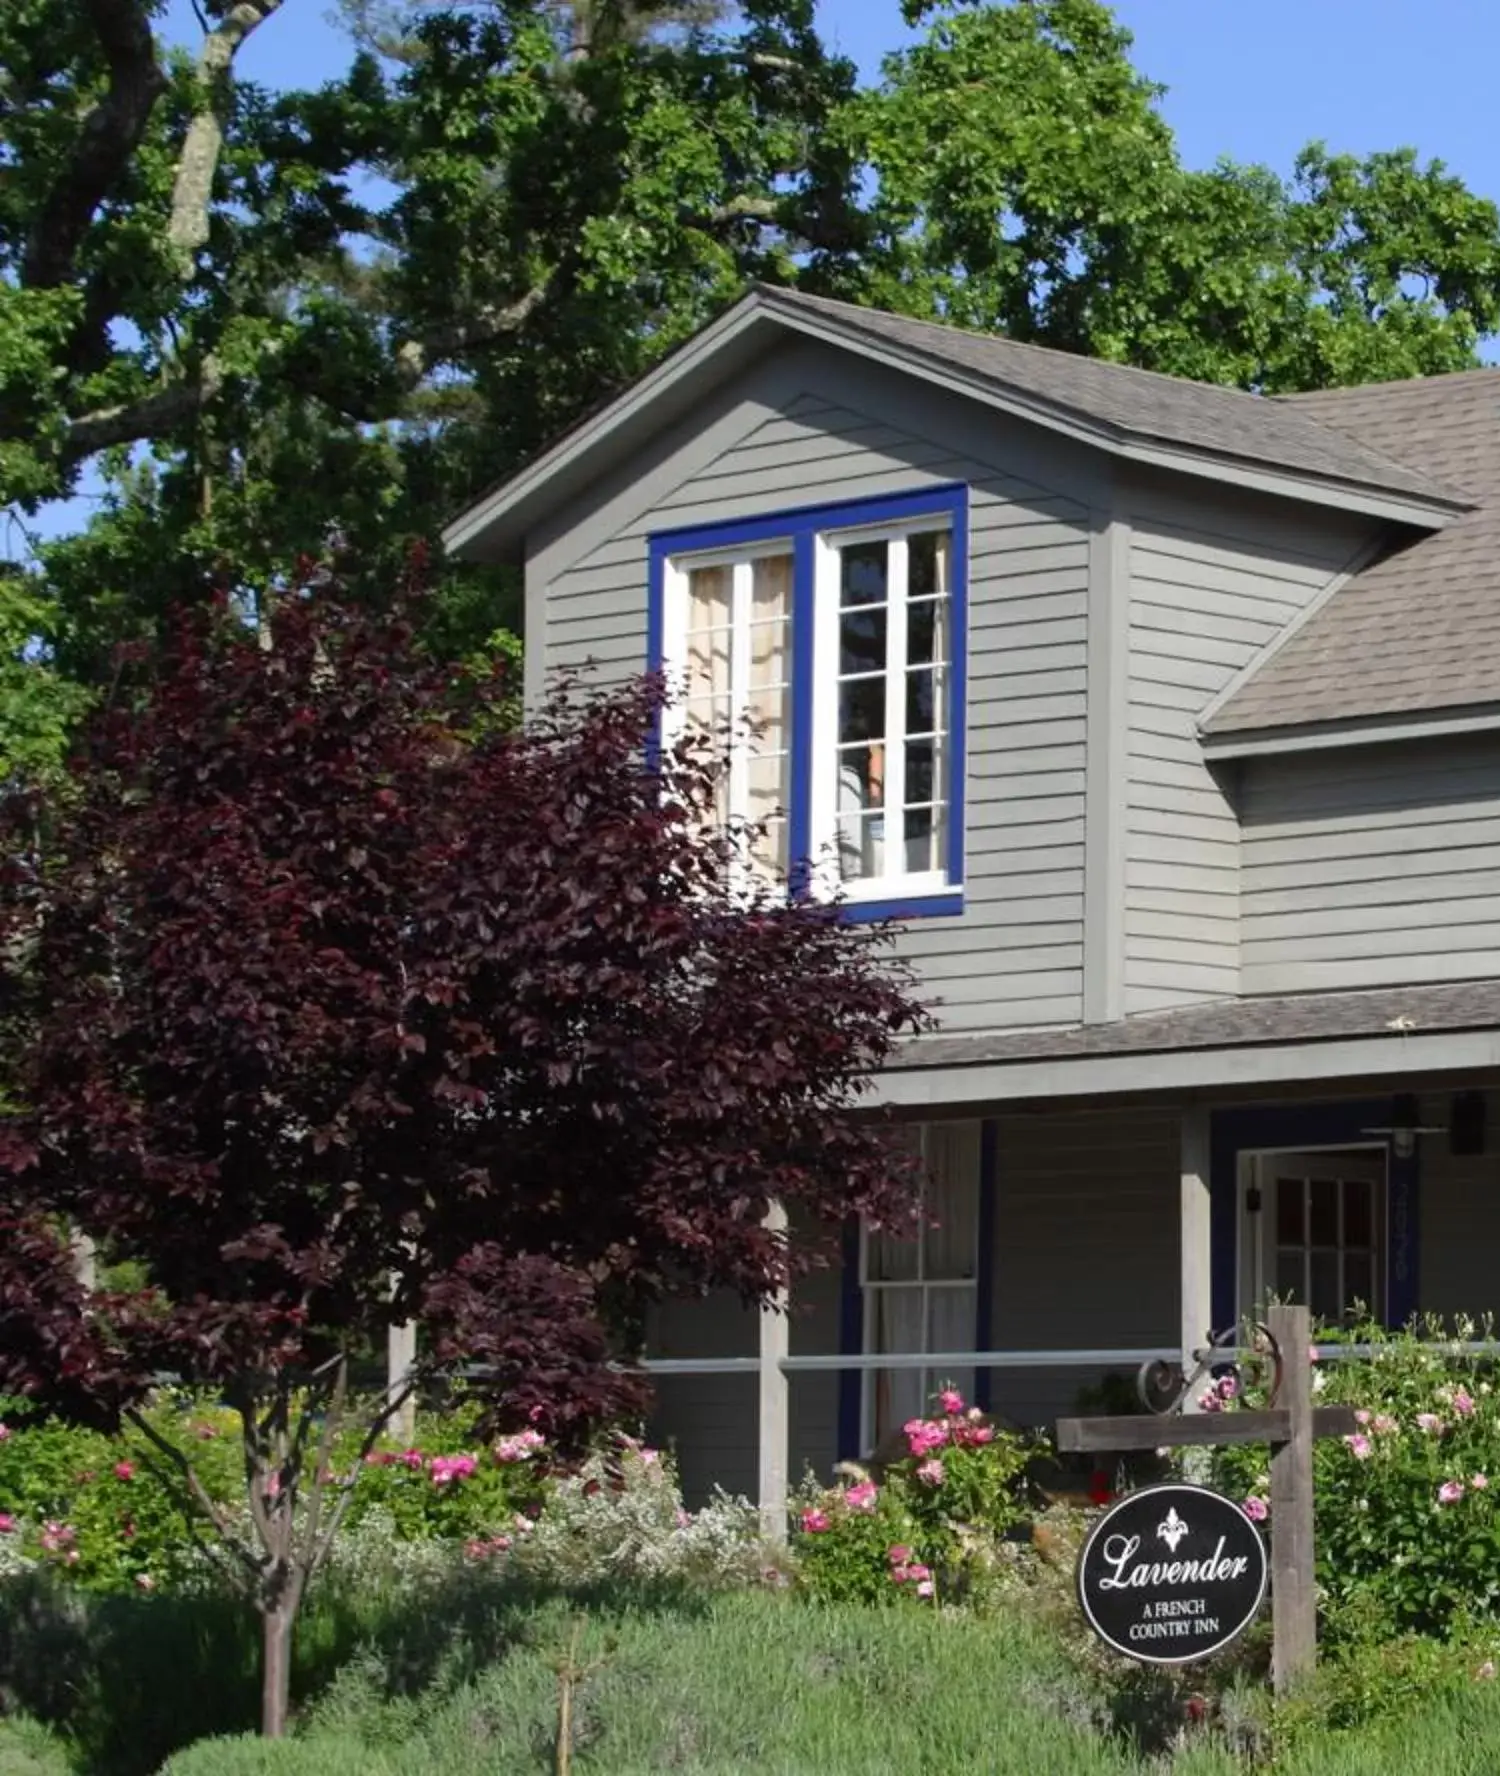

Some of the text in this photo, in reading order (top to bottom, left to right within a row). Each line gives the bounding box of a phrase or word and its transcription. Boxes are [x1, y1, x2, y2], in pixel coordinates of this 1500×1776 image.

[1099, 1533, 1248, 1590] Lavender
[1143, 1599, 1206, 1619] A FRENCH
[1129, 1617, 1220, 1640] COUNTRY INN
